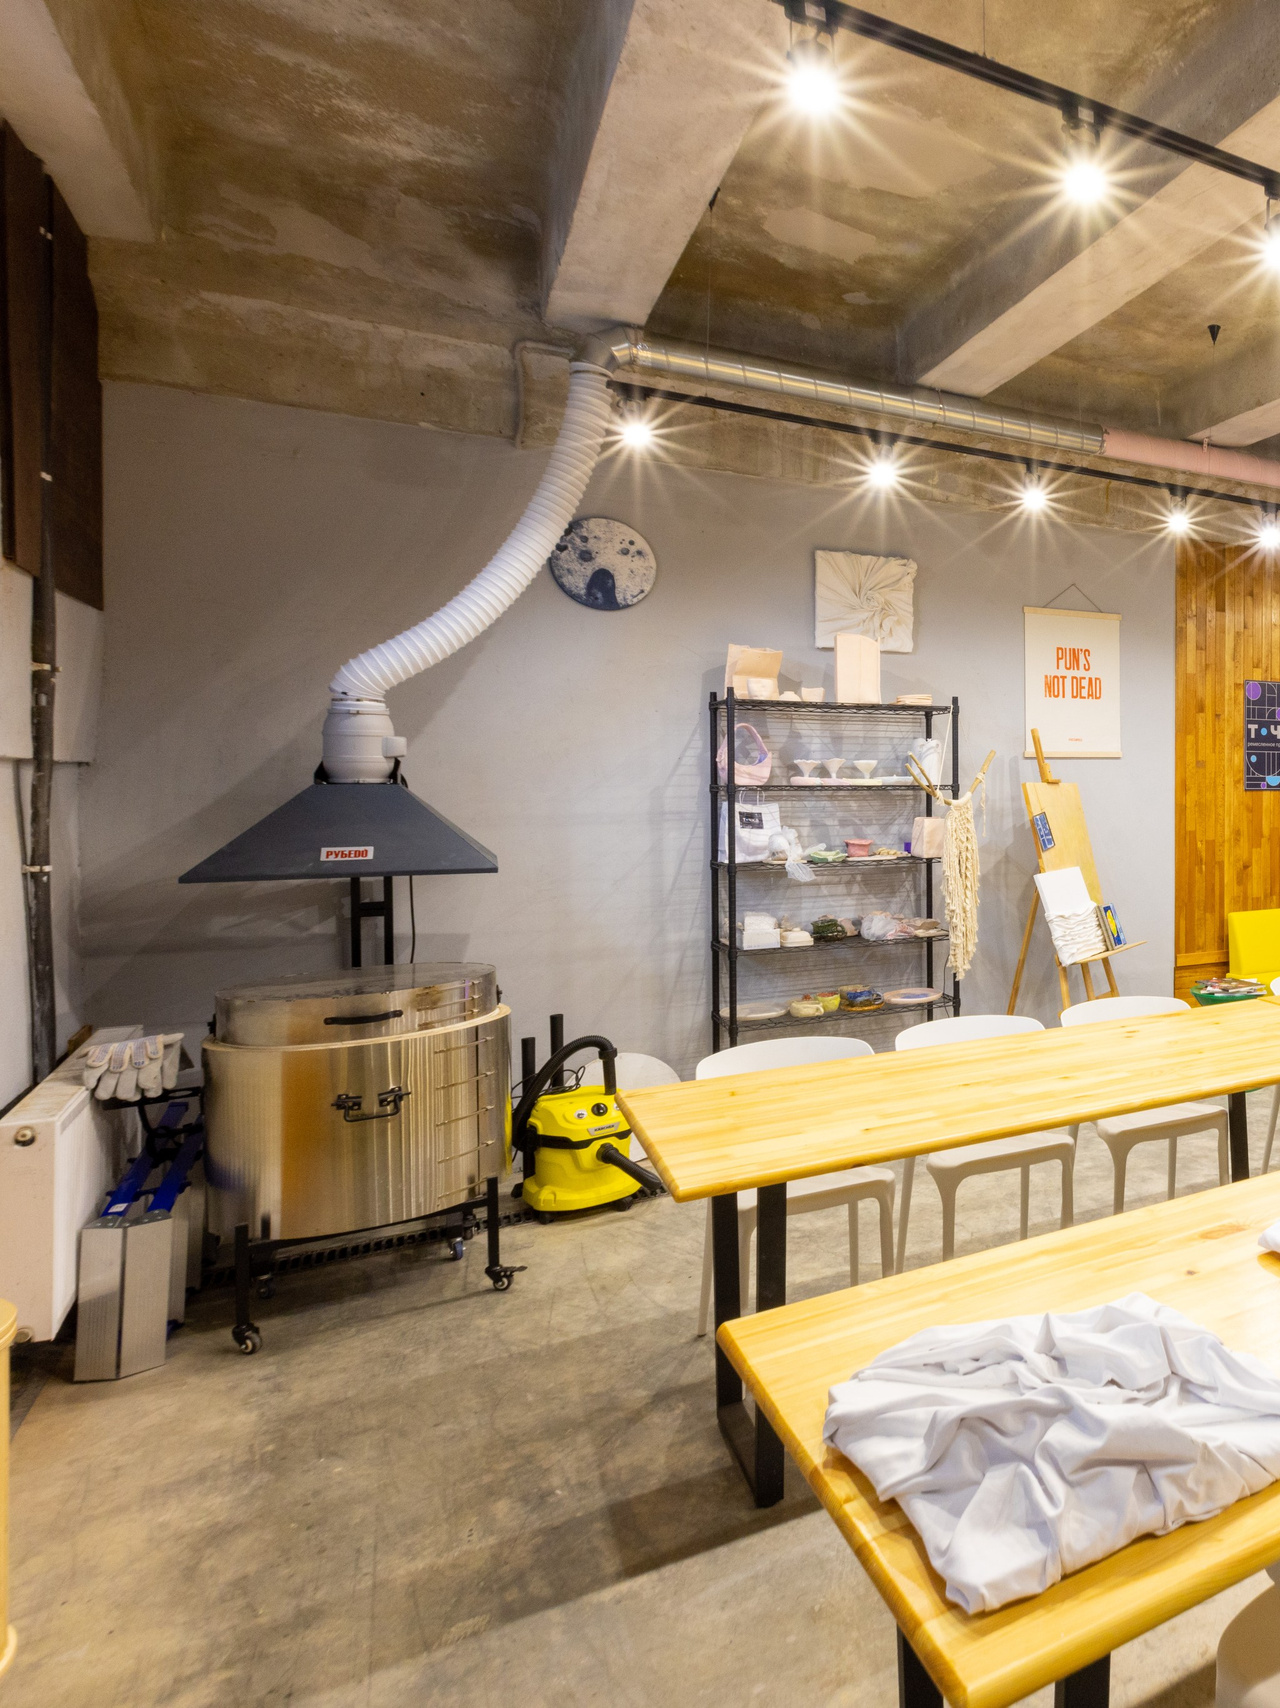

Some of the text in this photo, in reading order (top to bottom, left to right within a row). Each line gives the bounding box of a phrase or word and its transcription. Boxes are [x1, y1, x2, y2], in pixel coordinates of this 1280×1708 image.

[1056, 647, 1091, 671] PUN'S
[1044, 675, 1102, 699] NOT DEAD
